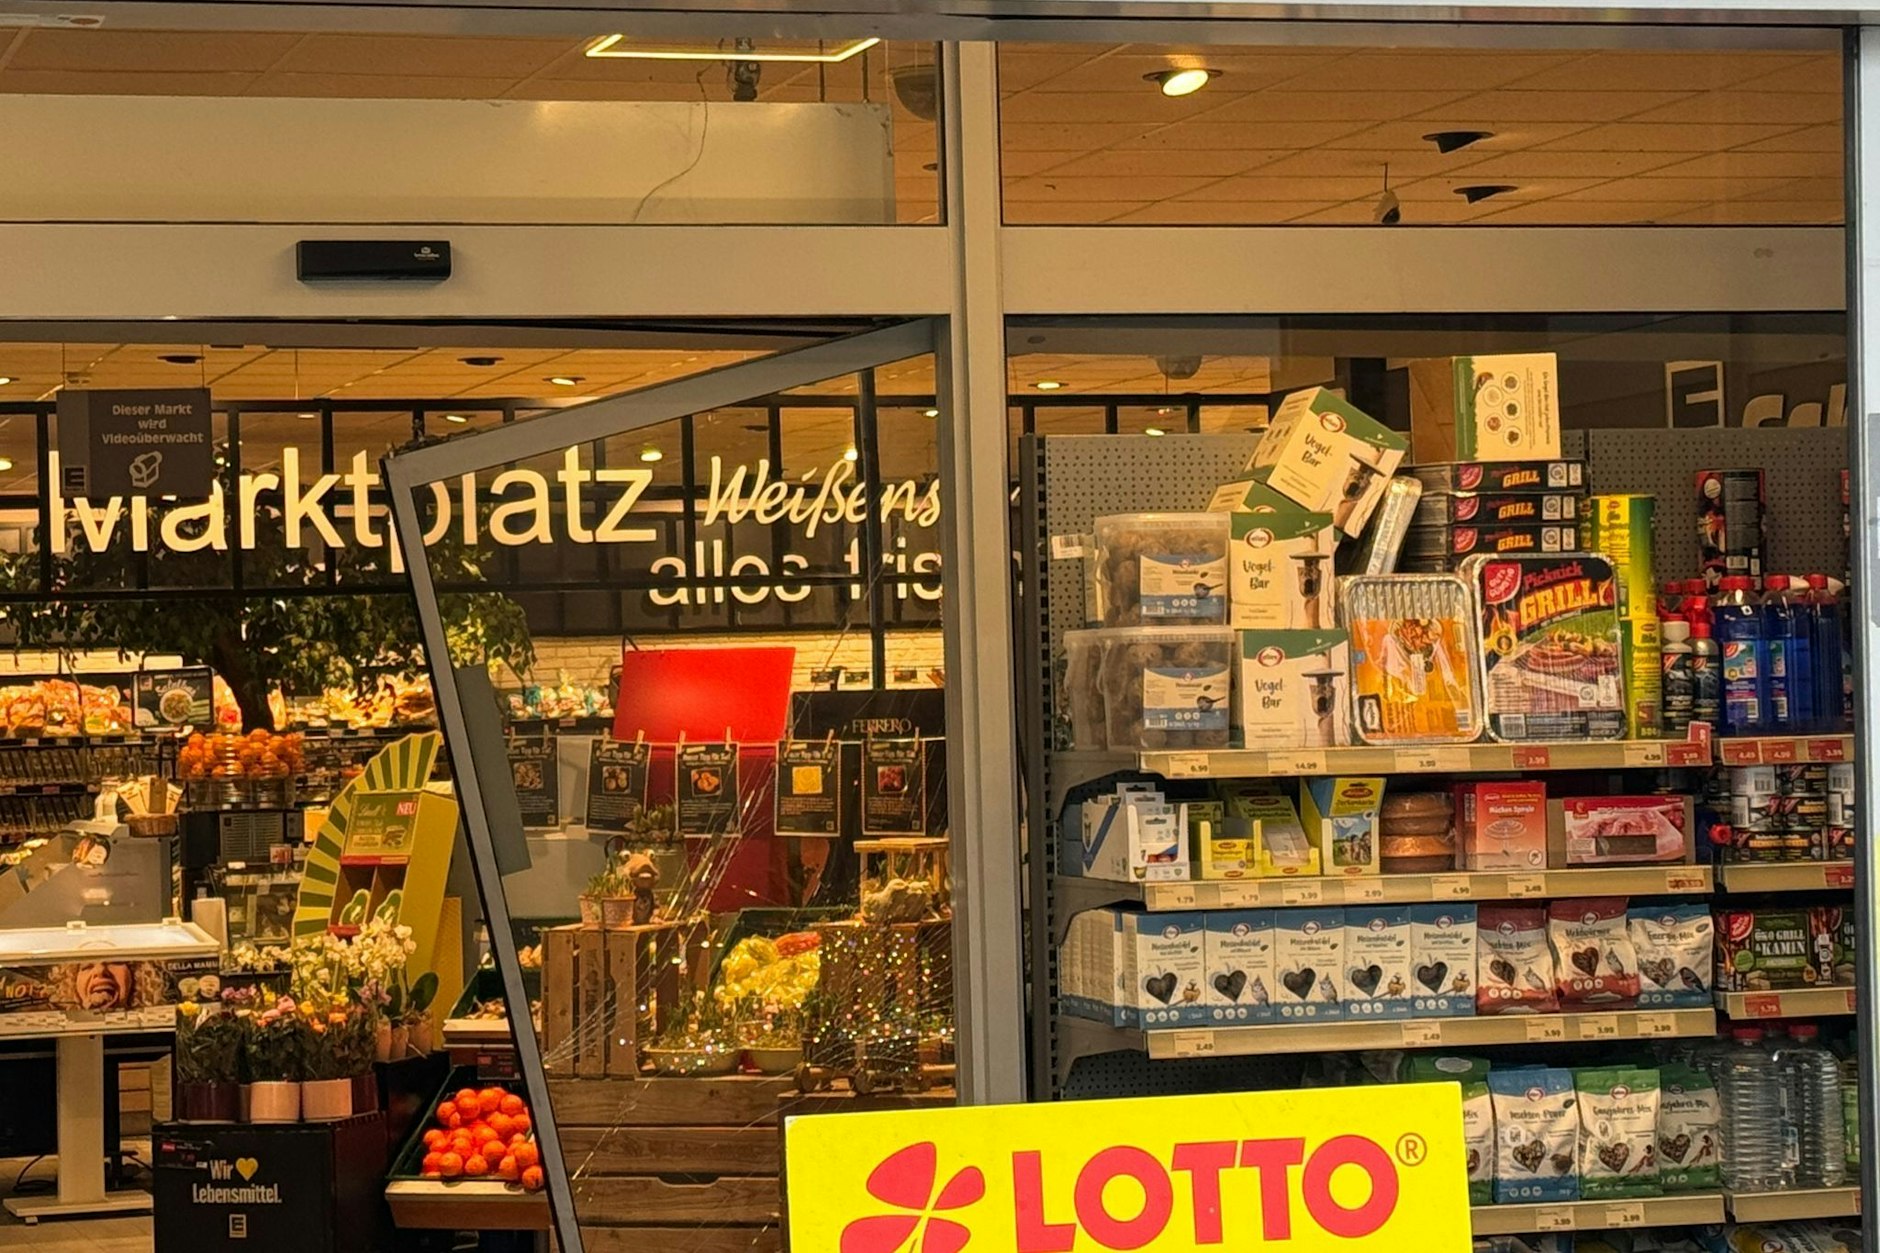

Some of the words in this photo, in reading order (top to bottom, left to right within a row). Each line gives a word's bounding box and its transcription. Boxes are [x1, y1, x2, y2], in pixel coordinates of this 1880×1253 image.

[112, 404, 150, 416] Dieser
[154, 404, 193, 415] Markt
[138, 419, 167, 429] wird
[1502, 469, 1540, 488] GRILL
[1498, 502, 1535, 520] GRILL
[1497, 534, 1534, 551] GRILL
[1520, 577, 1597, 629] GRILL
[852, 718, 912, 734] FERRERO
[396, 802, 416, 816] NEU
[1775, 929, 1805, 940] GRILL
[1762, 941, 1806, 956] KAMIN
[210, 1160, 233, 1180] Wir
[192, 1183, 282, 1204] Lebensmittel.
[1012, 1134, 1400, 1253] LOTTO
